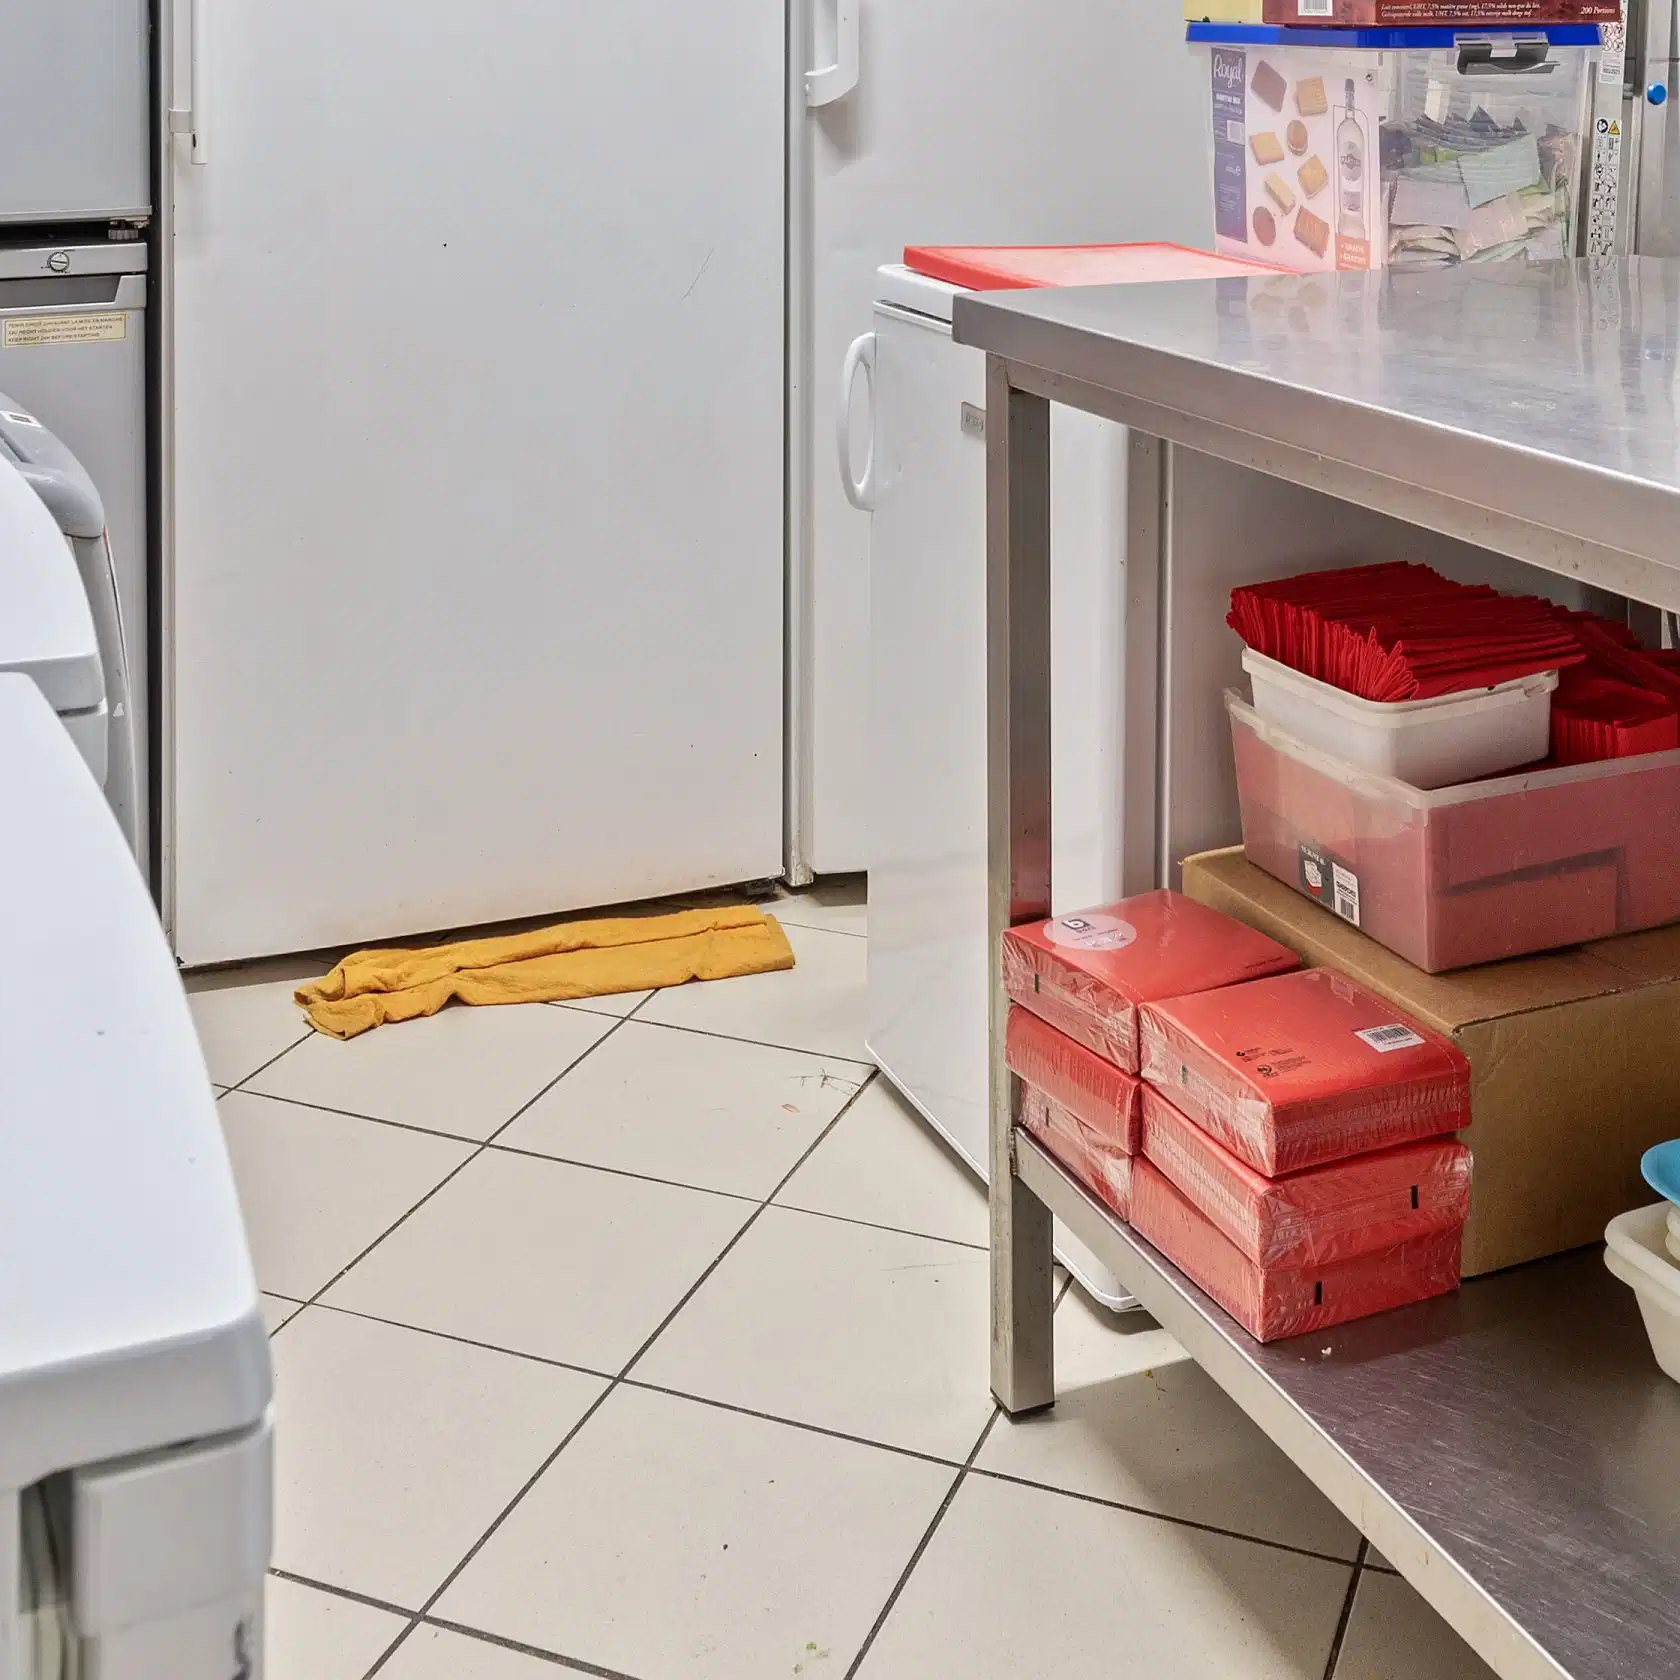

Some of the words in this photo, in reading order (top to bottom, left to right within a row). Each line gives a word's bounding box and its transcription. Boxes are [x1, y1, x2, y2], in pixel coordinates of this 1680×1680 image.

[1580, 6, 1593, 15] 200
[1593, 6, 1616, 15] Portions
[1213, 53, 1243, 88] Royal
